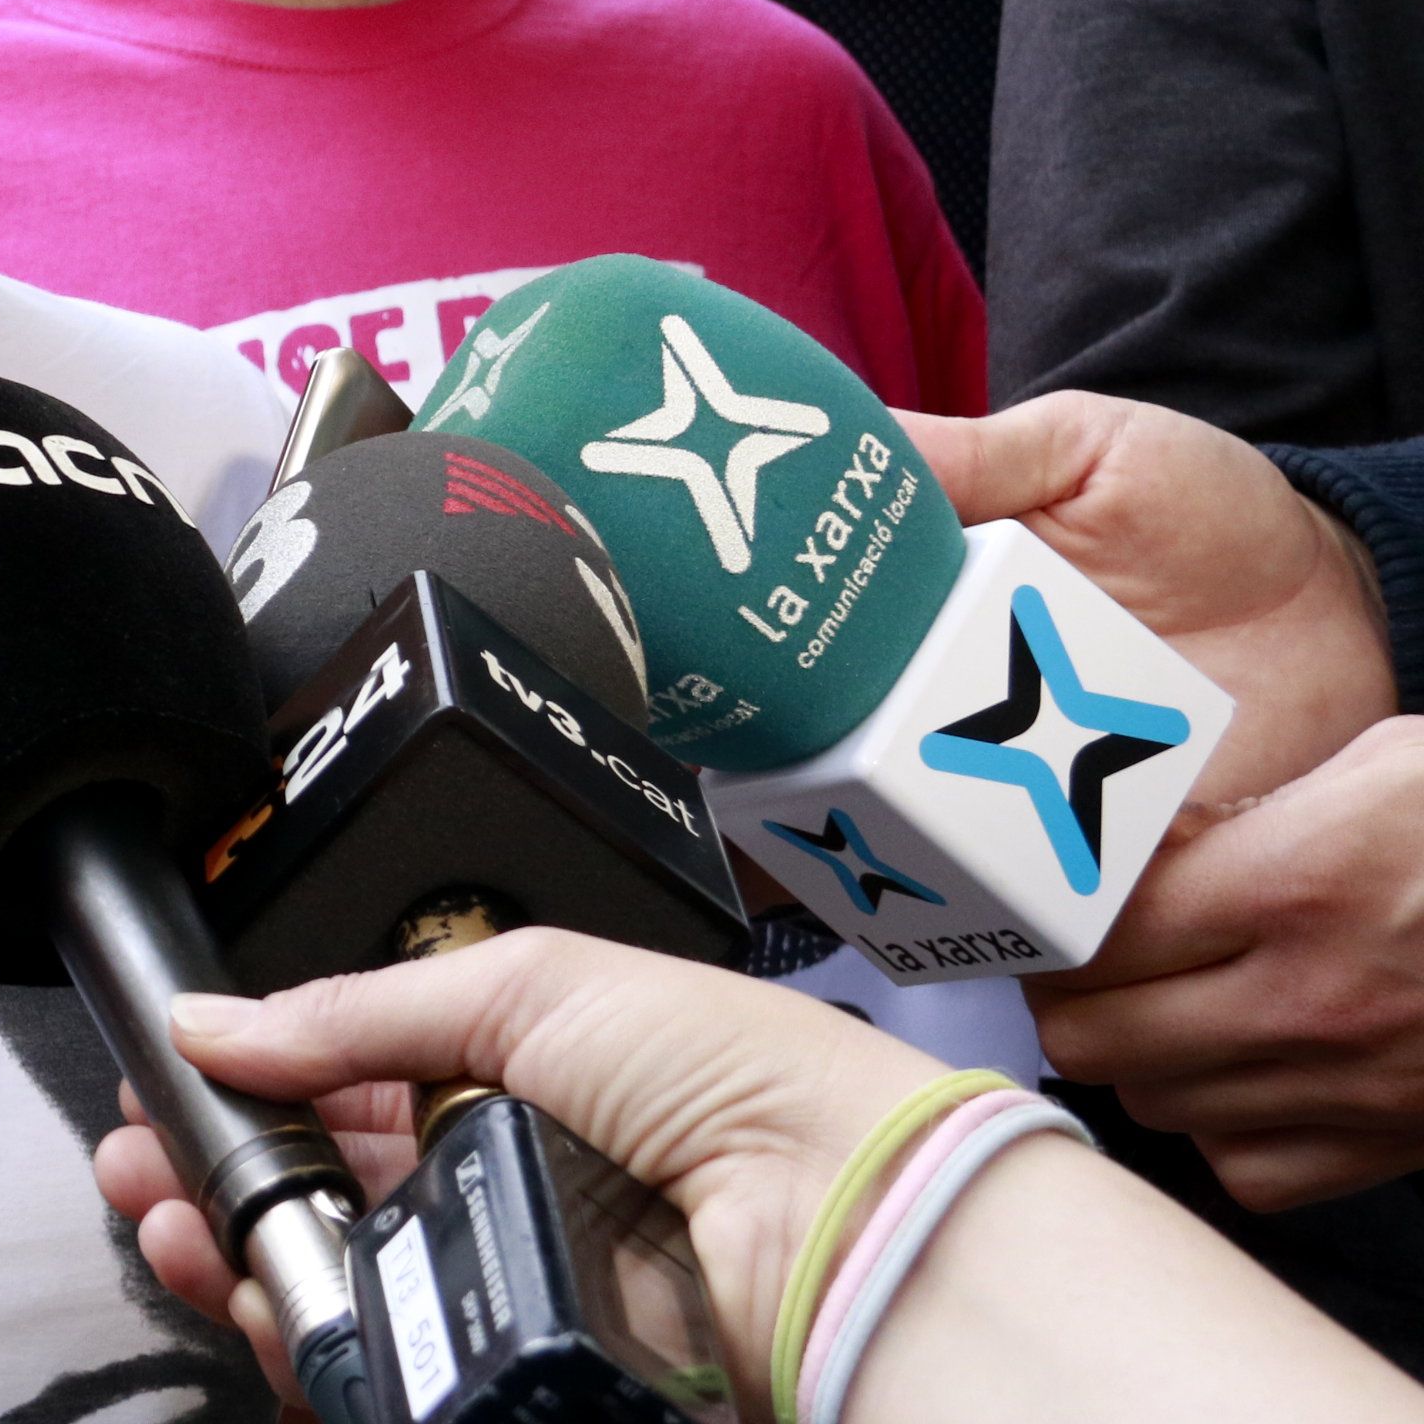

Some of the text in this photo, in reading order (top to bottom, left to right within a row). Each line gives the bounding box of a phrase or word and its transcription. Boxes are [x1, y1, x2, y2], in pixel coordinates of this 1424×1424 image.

[737, 432, 893, 643] la xarxa
[881, 466, 919, 525] local
[480, 649, 700, 838] tv3.cat
[857, 928, 1042, 972] la xarxa
